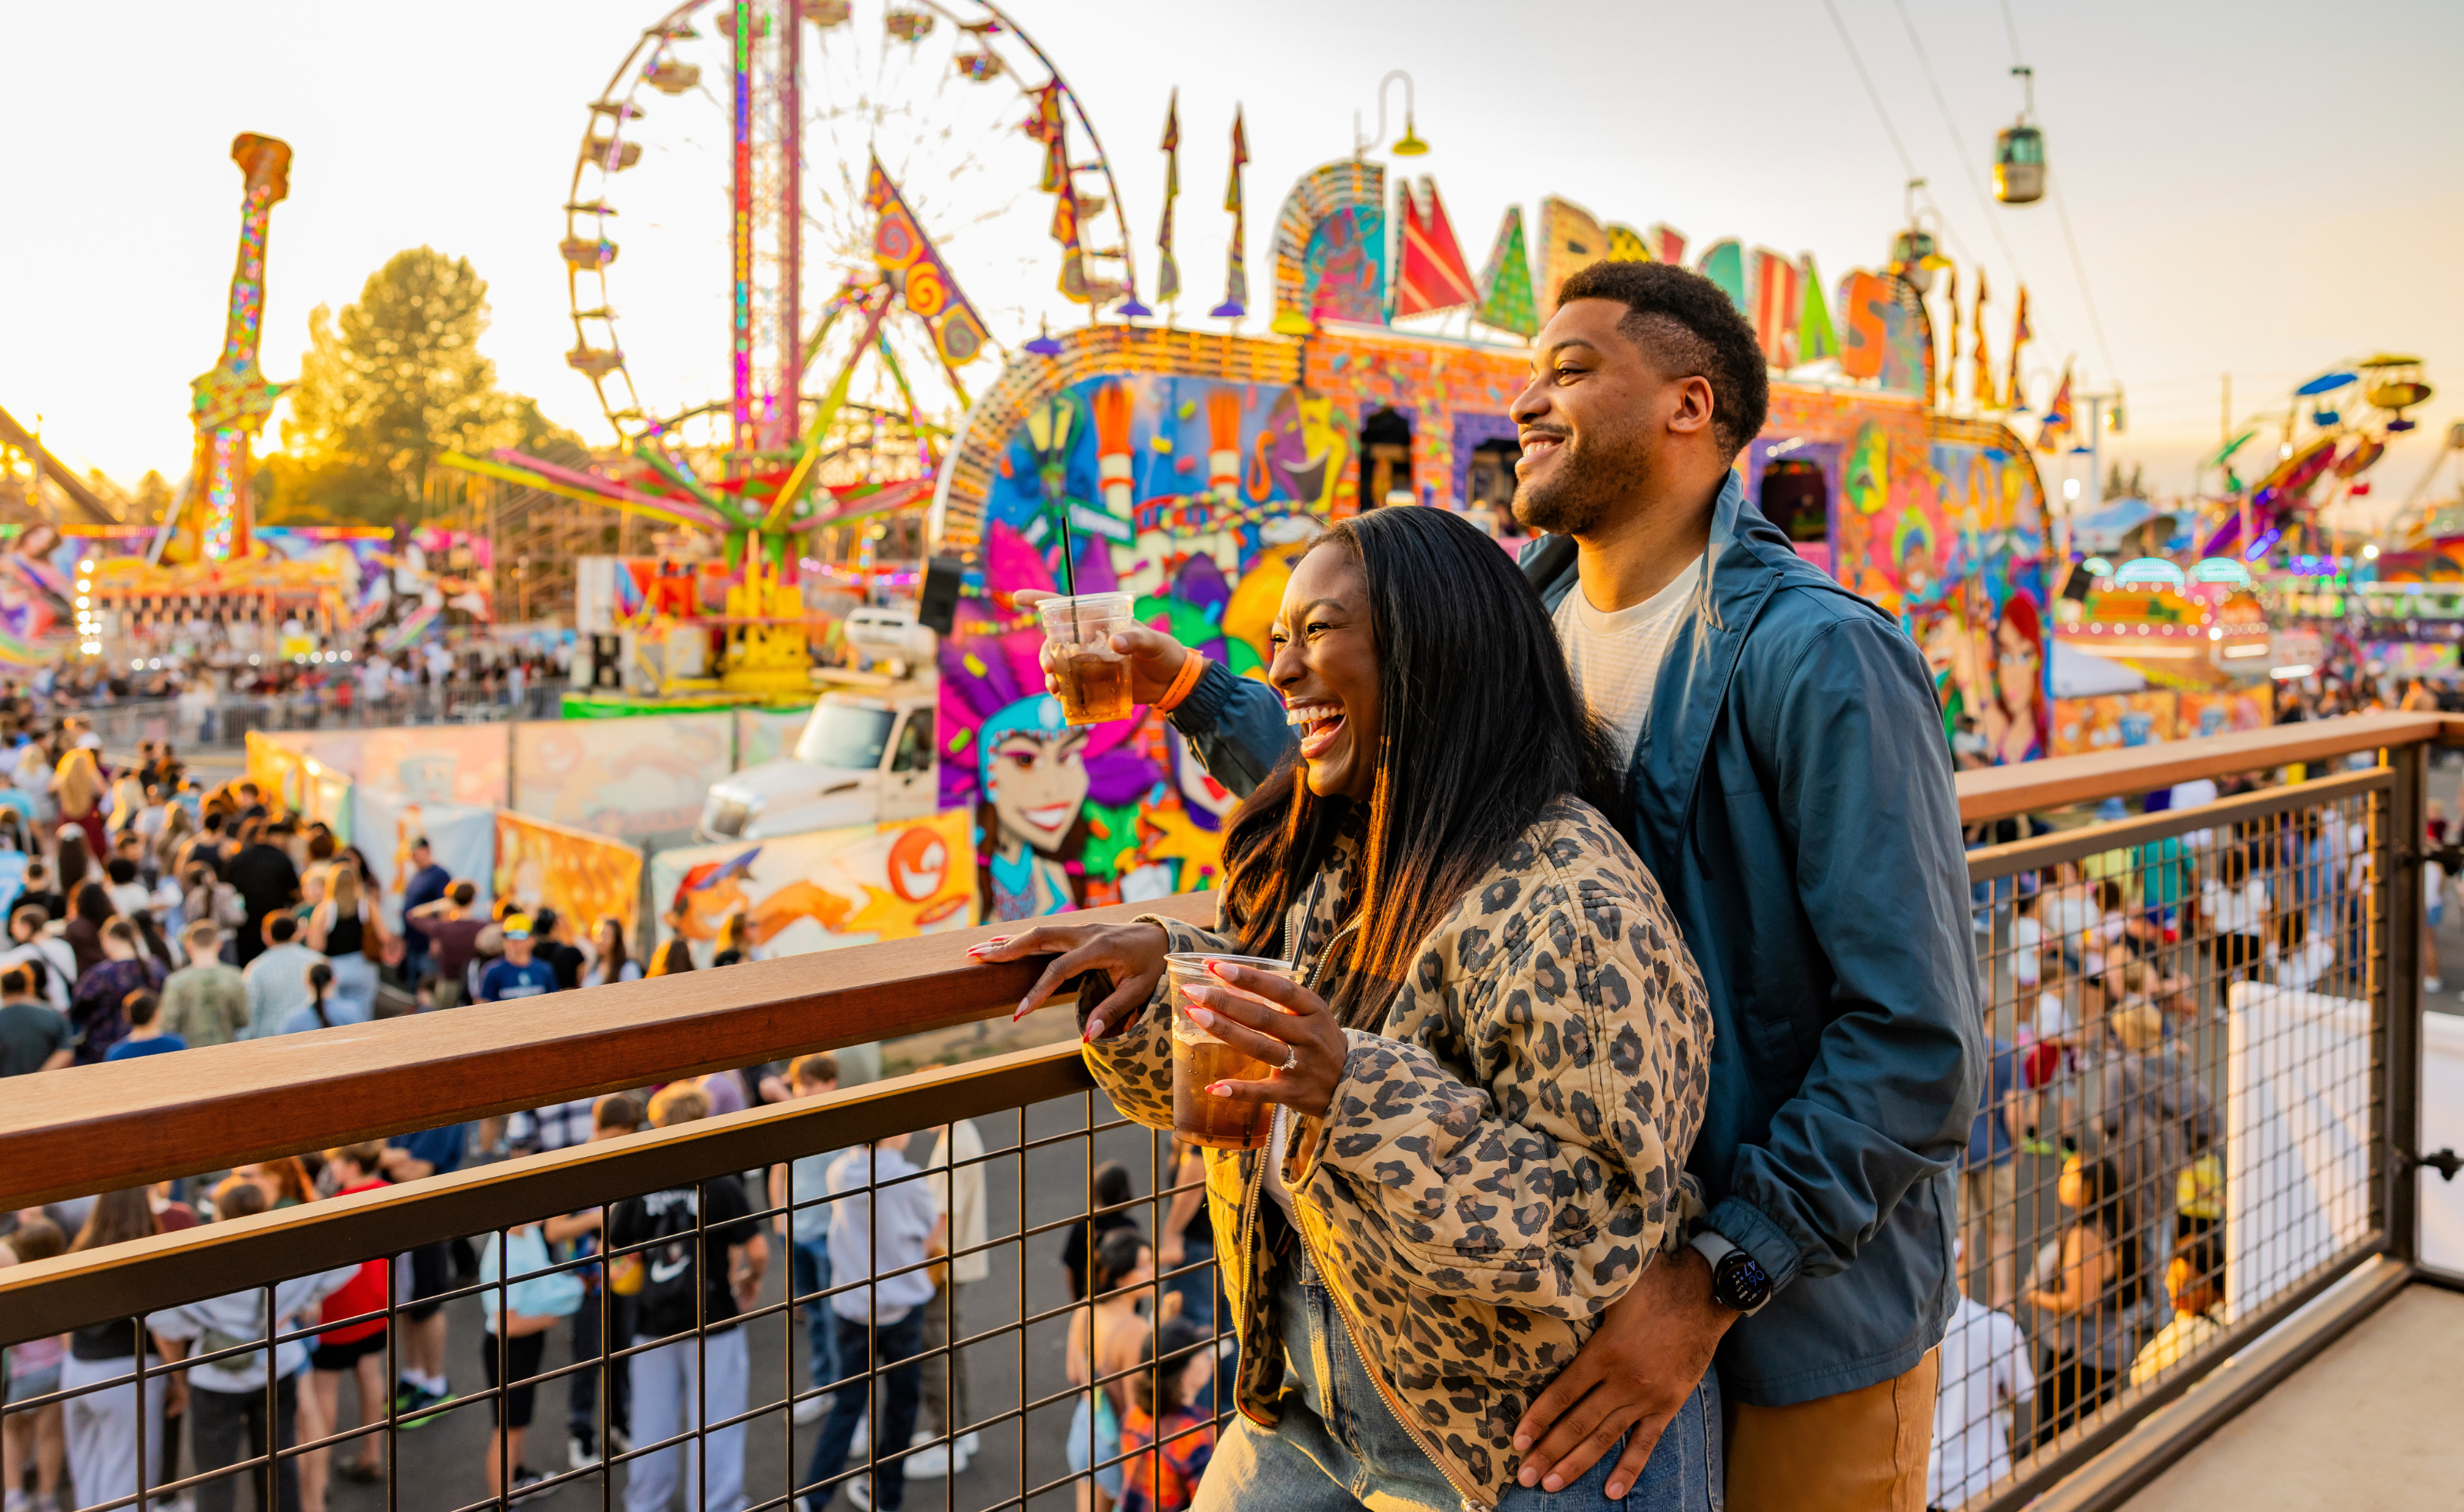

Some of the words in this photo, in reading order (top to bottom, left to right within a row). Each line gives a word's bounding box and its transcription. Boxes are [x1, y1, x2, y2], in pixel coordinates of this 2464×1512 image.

[1391, 176, 1686, 337] MAR
[1744, 1260, 1755, 1276] 47
[1749, 1270, 1764, 1286] 06
